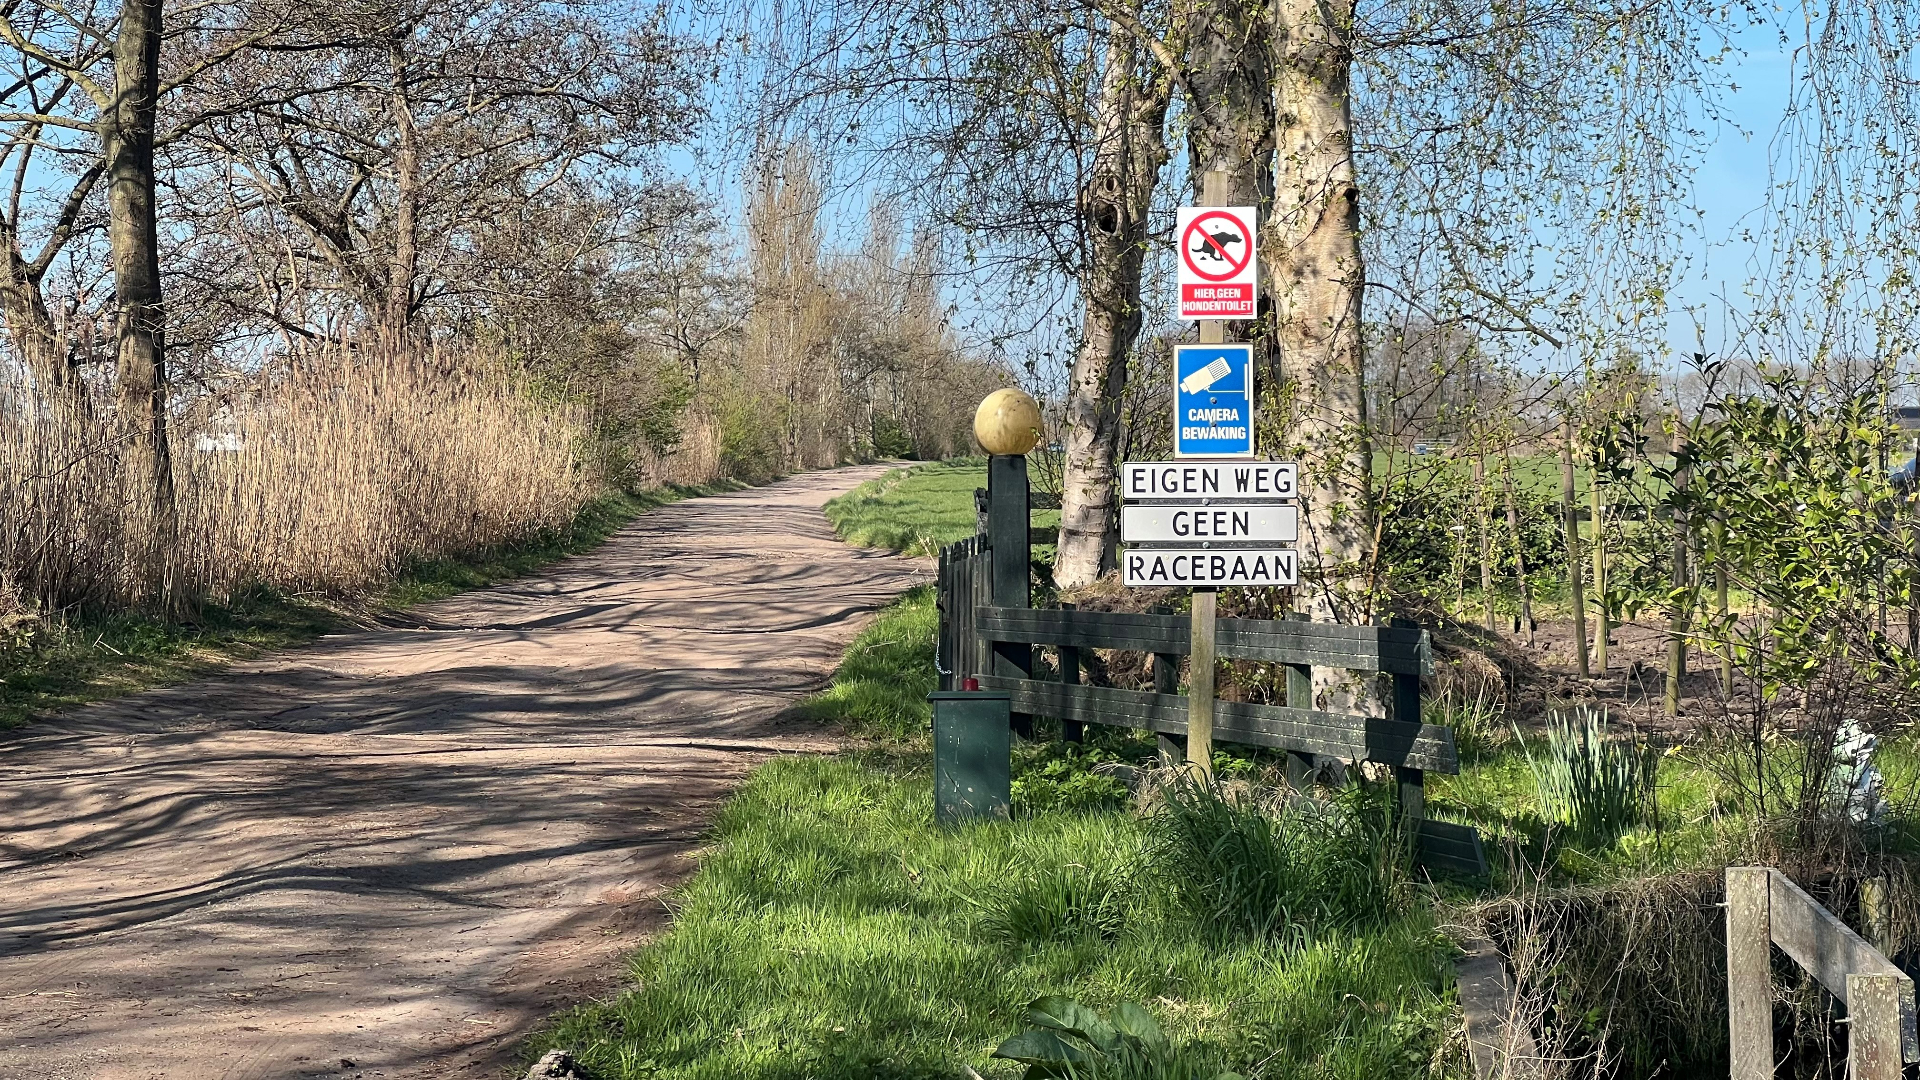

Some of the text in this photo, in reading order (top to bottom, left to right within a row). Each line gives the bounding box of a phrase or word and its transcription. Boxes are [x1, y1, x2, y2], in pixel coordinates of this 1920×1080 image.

[1194, 288, 1241, 299] HIER GEEN
[1183, 301, 1252, 311] HONDENTOILET
[1188, 408, 1239, 421] CAMERA
[1182, 427, 1246, 440] BEWAKING
[1132, 468, 1291, 493] EIGEN WEG
[1172, 511, 1249, 536] GEEN
[1129, 555, 1292, 581] RACEBAAN
